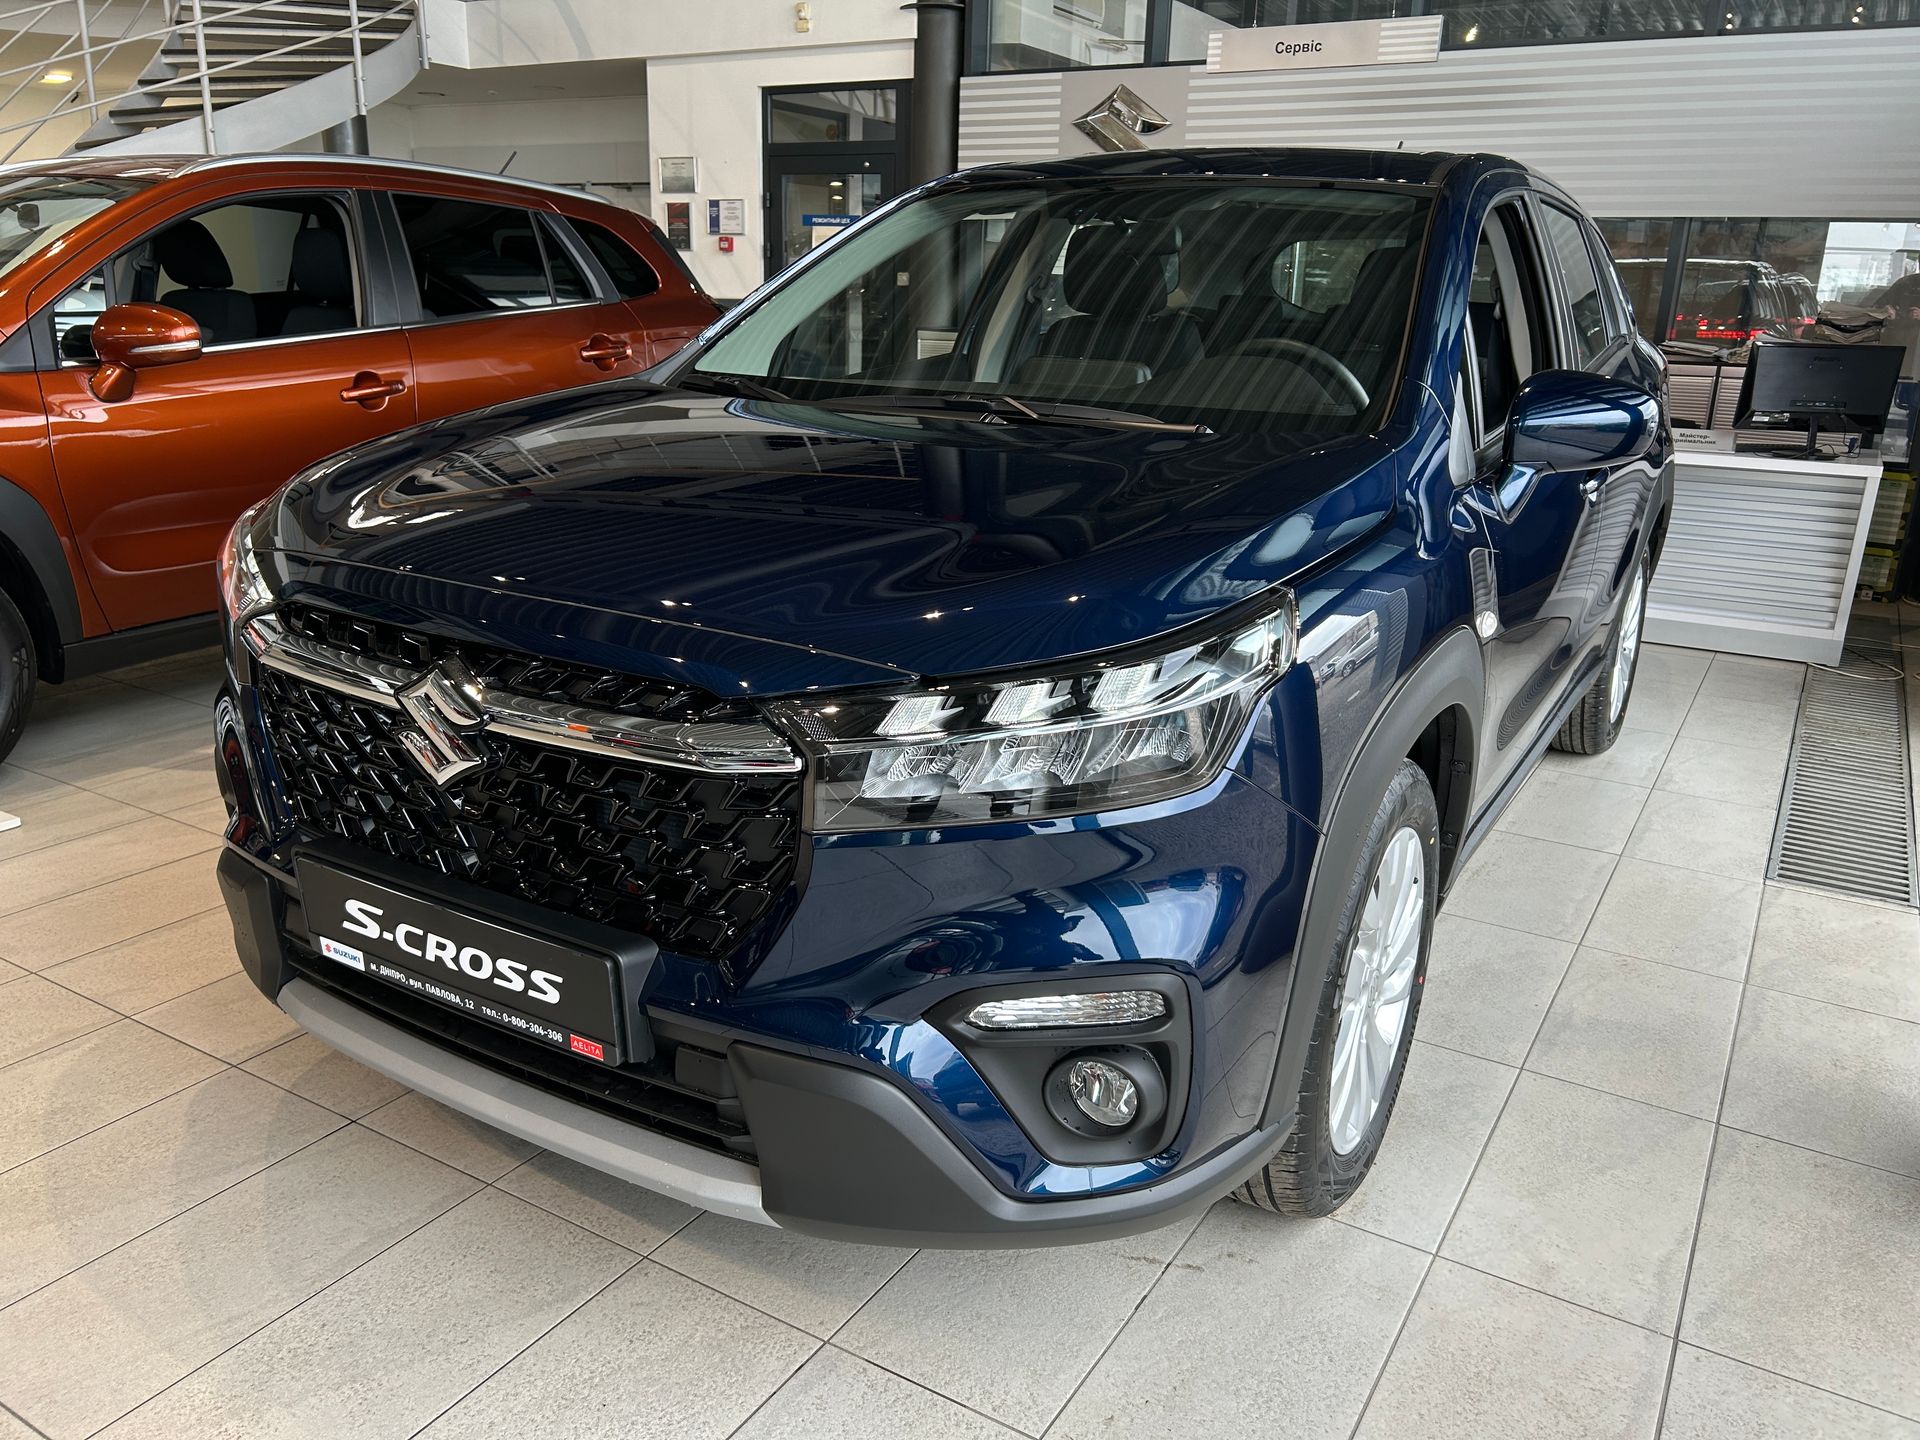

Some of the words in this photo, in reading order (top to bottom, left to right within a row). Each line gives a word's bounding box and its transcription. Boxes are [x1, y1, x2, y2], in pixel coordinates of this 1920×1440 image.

[1275, 40, 1322, 56] Сервіс
[333, 947, 361, 963] SUZUKI
[380, 965, 409, 985] ДНІПРО,
[425, 983, 464, 1007] ПАВЛОВА,
[465, 999, 475, 1010] 12
[481, 1006, 501, 1019] тел.:
[502, 1013, 563, 1042] 0-800-304-306
[573, 1040, 601, 1056] AELITA
